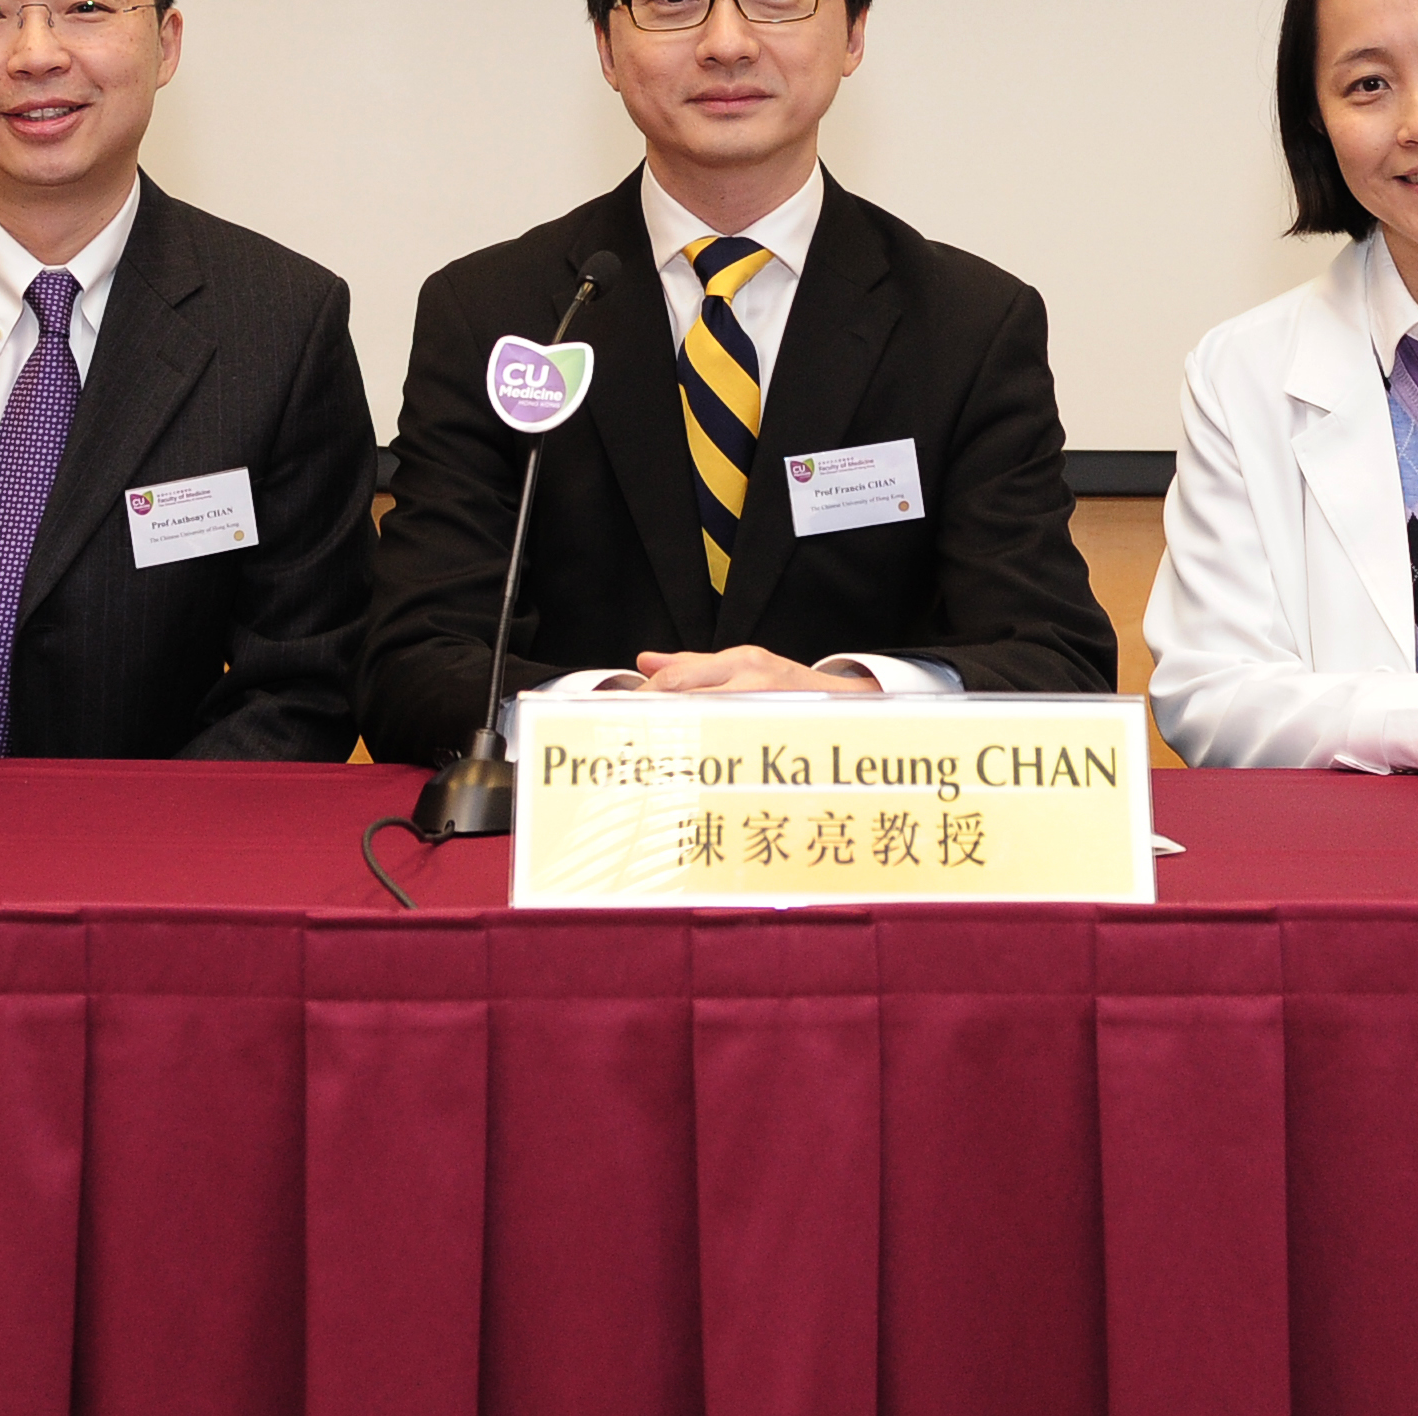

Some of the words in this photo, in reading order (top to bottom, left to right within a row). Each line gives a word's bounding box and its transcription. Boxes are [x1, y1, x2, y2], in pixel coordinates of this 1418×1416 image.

[502, 362, 549, 387] CU
[499, 385, 563, 401] Medicine
[793, 464, 805, 474] CU
[814, 487, 833, 498] Prof
[835, 484, 866, 495] Francis
[867, 477, 896, 489] CHAN
[132, 497, 146, 507] CU
[151, 519, 170, 530] Prof
[171, 513, 205, 527] Anthony
[206, 507, 234, 520] CHAN
[542, 741, 743, 787] Professor
[760, 744, 812, 786] Ka
[830, 745, 960, 800] Leung
[975, 744, 1118, 788] CHAN
[677, 810, 986, 867] 陳家亮教授
